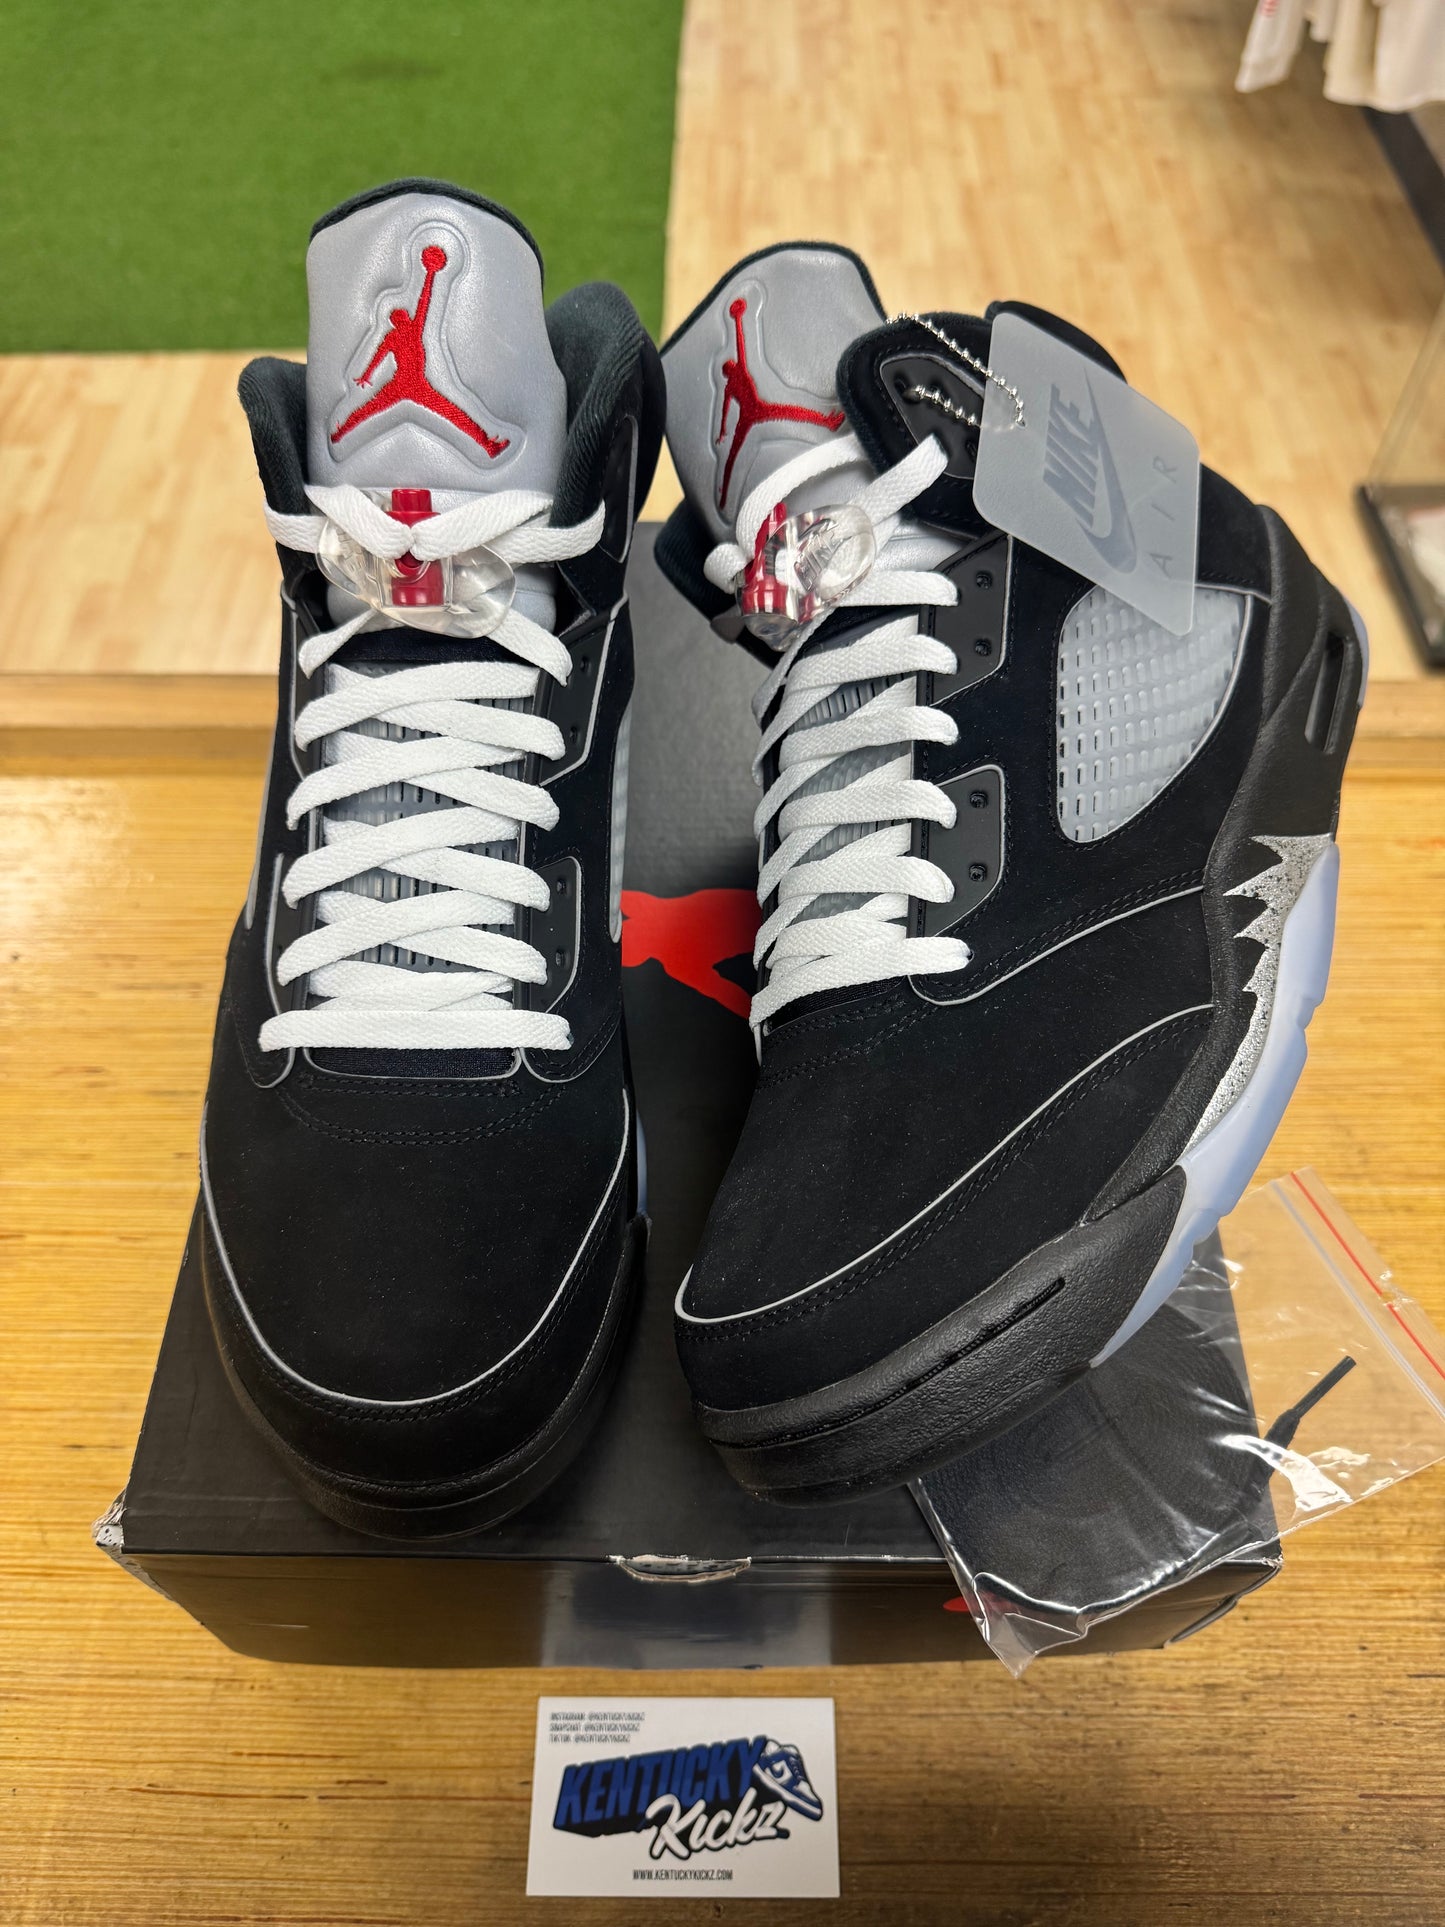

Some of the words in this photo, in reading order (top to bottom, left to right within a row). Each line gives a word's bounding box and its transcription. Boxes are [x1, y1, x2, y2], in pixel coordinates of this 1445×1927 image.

[1043, 383, 1099, 528] NIKE
[1149, 455, 1178, 577] AIR
[554, 1736, 768, 1830] KENTUCKY
[646, 1787, 788, 1861] Kickz
[632, 1869, 733, 1880] WWW.KENTUCKYKICKZ.COM
